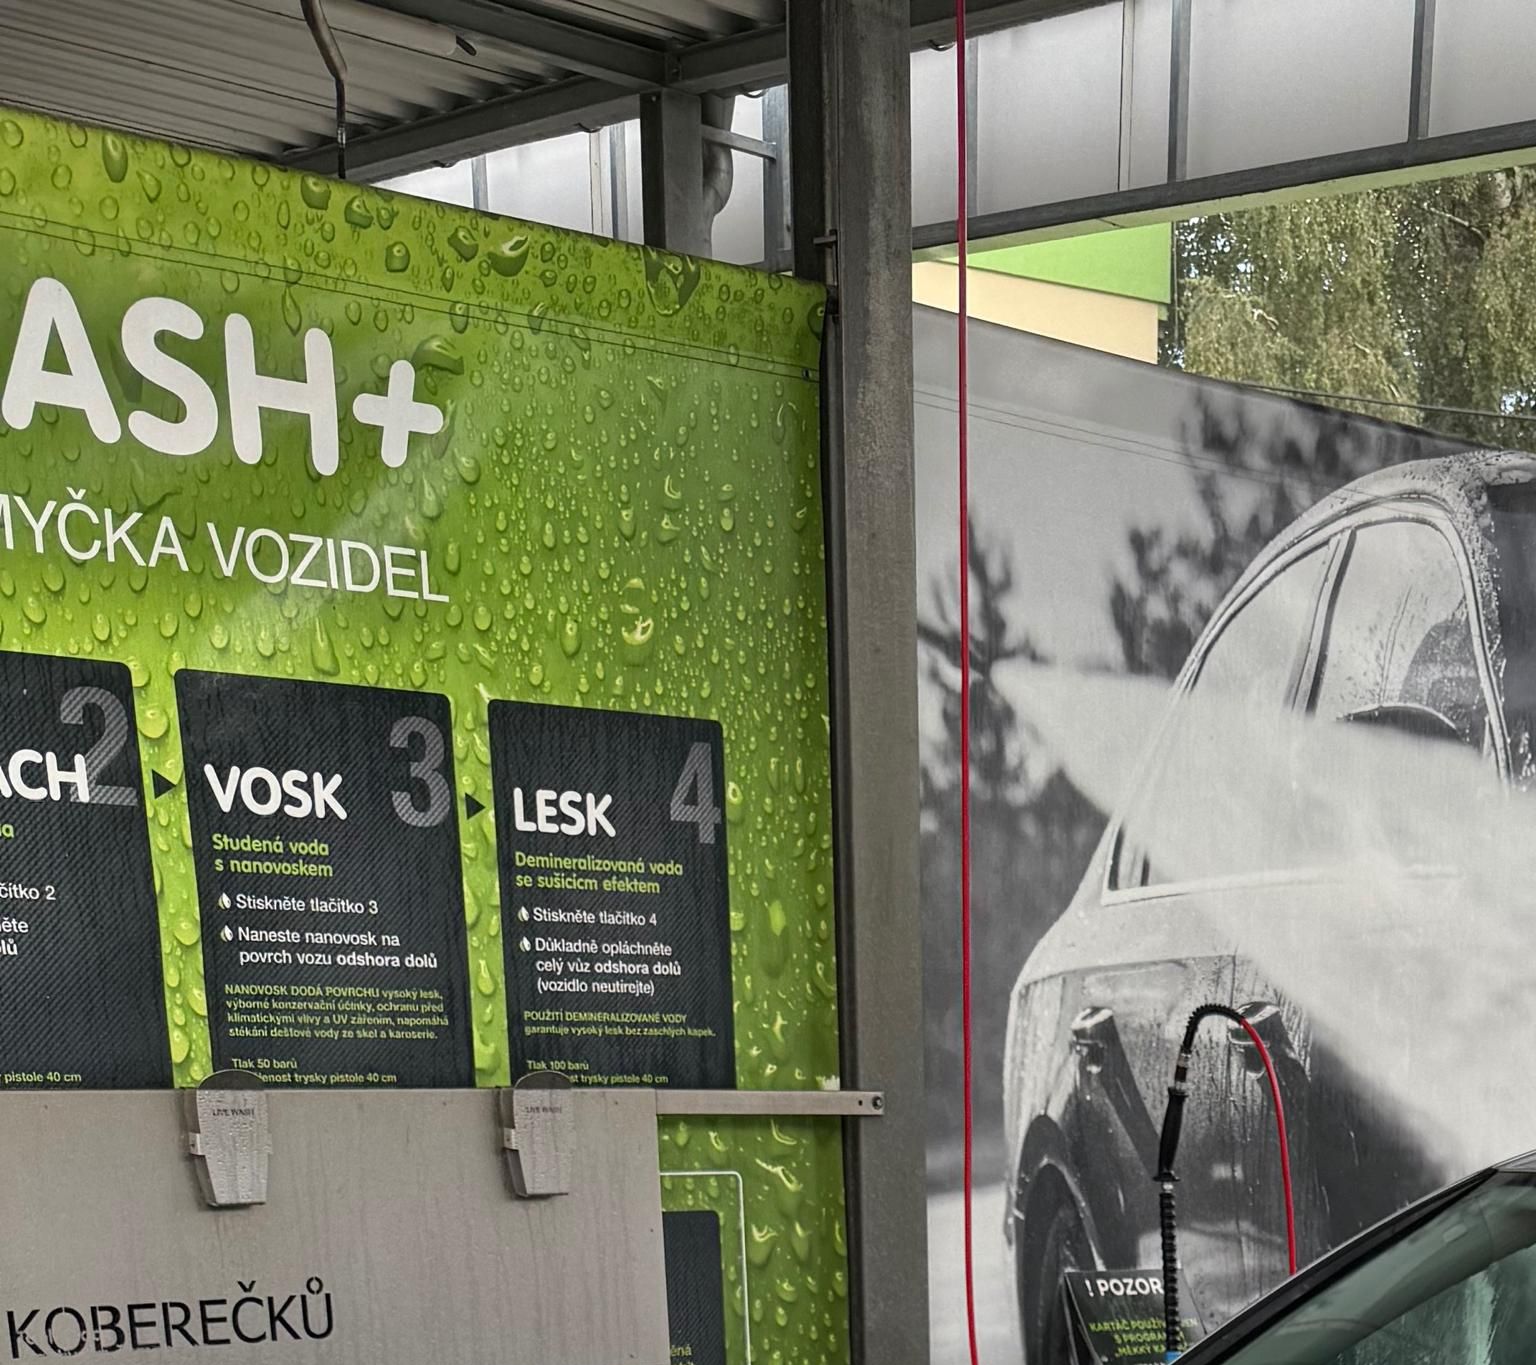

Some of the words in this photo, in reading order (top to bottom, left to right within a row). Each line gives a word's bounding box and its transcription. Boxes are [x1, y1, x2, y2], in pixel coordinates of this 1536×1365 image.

[207, 522, 449, 603] VOZIDEL
[60, 686, 138, 806] 2
[388, 717, 452, 828] 3
[204, 763, 347, 820] VOSK
[669, 741, 722, 845] 4
[513, 787, 616, 838] LESK
[212, 833, 283, 854] Studená
[289, 840, 329, 856] voda
[215, 859, 224, 872] s
[230, 859, 333, 877] nanovoskem
[515, 851, 645, 874] Demineralizovaná
[649, 860, 683, 876] voda
[45, 885, 56, 900] 2
[515, 875, 532, 887] se
[602, 876, 660, 894] efektem
[236, 893, 305, 911] Stiskněte
[310, 897, 364, 914] tlačítko
[369, 900, 379, 914] 3
[533, 907, 595, 924] Stiskněte
[599, 910, 646, 926] tlačítko
[649, 913, 657, 926] 4
[238, 927, 300, 942] Naneste
[305, 931, 377, 946] nanovosk
[382, 934, 400, 947] na
[535, 937, 598, 954] Důkladně
[602, 940, 673, 958] opláchněte
[239, 950, 291, 966] povrch
[297, 953, 331, 965] vozu
[336, 952, 400, 967] odshora
[405, 953, 438, 968] dolů
[536, 958, 564, 976] celý
[567, 958, 591, 973] vůz
[595, 960, 649, 975] odshora
[653, 961, 681, 976] dolů
[225, 984, 288, 996] NANOVOSK
[291, 985, 323, 997] DODÁ
[326, 987, 379, 998] POVRCHU
[382, 989, 417, 1001] vysoký
[537, 977, 588, 994] (vozidlo
[226, 999, 269, 1012] výborné
[272, 999, 335, 1012] konzervační
[333, 1014, 348, 1025] UV
[662, 1013, 687, 1023] VODY
[314, 1028, 339, 1040] vody
[525, 1026, 569, 1036] garantuje
[571, 1026, 603, 1037] vysoký
[232, 1058, 255, 1069] Tlak
[257, 1059, 270, 1069] 50
[273, 1058, 298, 1069] barů
[527, 1060, 547, 1070] Tlak
[550, 1060, 566, 1070] 100
[4, 1071, 43, 1084] pistole
[46, 1072, 61, 1082] 40
[64, 1073, 82, 1082] cm
[294, 1073, 327, 1084] trysky
[330, 1073, 364, 1084] pistole
[366, 1073, 379, 1082] 40
[381, 1074, 397, 1082] cm
[581, 1074, 609, 1085] trysky
[611, 1074, 640, 1085] pistole
[642, 1074, 653, 1083] 40
[655, 1075, 668, 1083] cm
[1096, 1277, 1164, 1296] POZOR
[7, 1276, 334, 1359] KOBEREČKŮ
